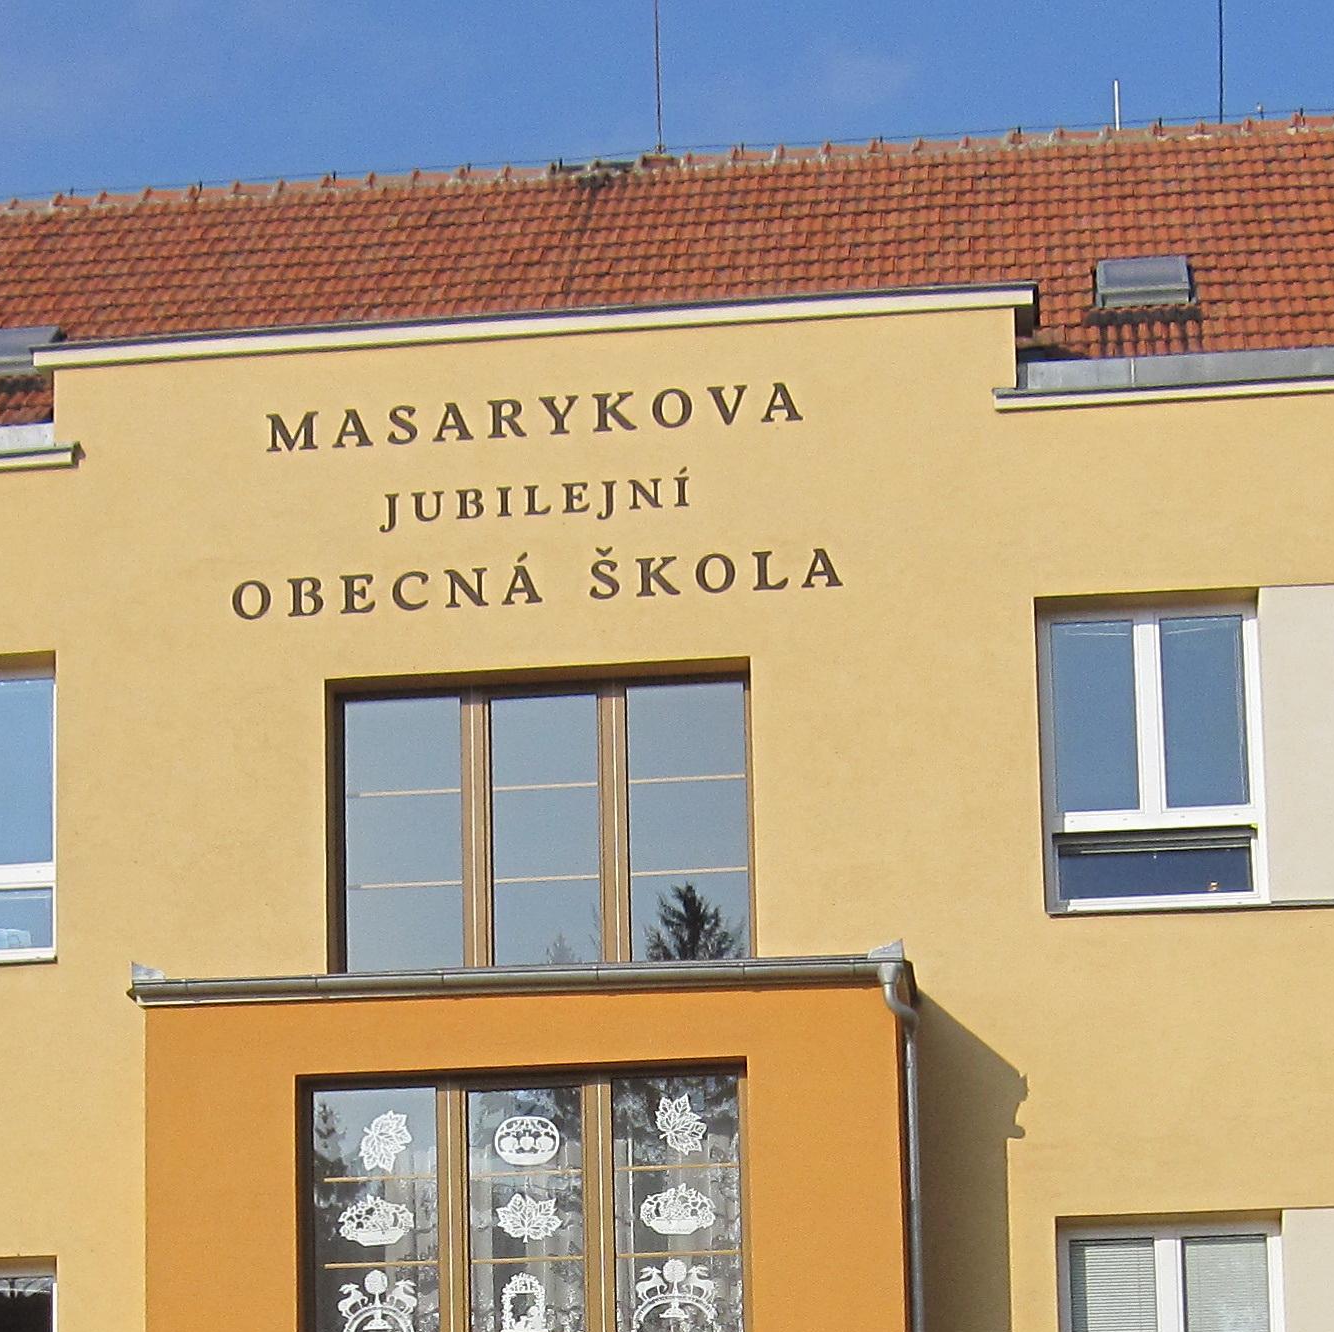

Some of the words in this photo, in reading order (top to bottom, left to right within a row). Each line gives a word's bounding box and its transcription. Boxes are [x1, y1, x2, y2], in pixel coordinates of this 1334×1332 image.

[266, 381, 804, 453] MASARYKOVA
[379, 466, 689, 533] JUBILEJNÍ
[231, 552, 543, 621] OBECNÁ
[589, 546, 844, 600] ŠKOLA
